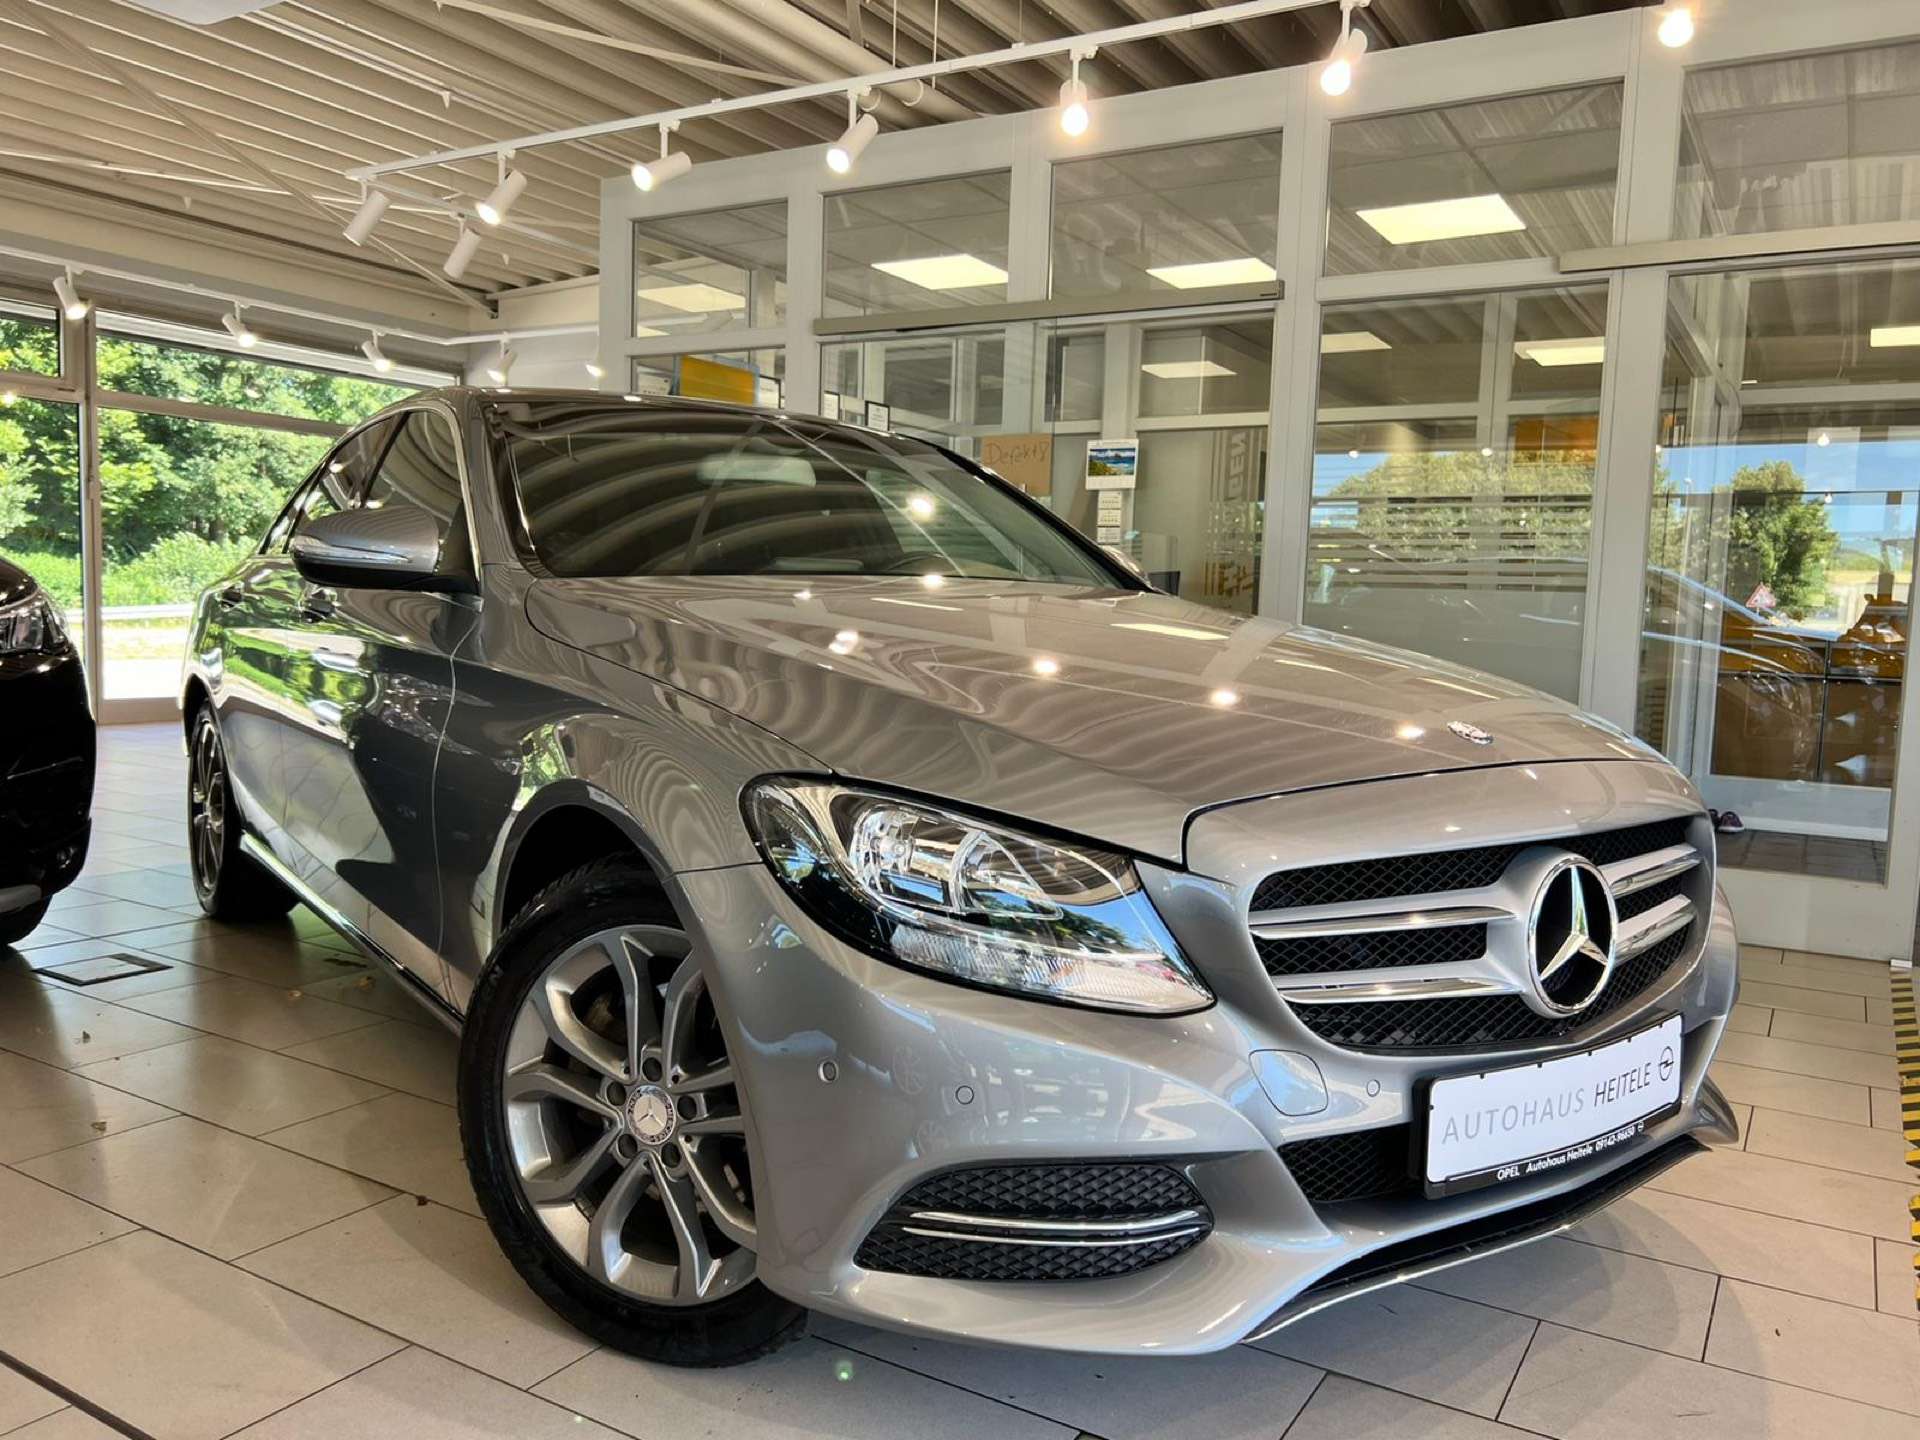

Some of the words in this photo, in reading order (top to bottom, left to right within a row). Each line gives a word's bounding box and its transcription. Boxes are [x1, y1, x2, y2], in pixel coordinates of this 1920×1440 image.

[1441, 1088, 1585, 1145] AUTOHAUS
[1593, 1062, 1652, 1107] HEITELE
[1496, 1165, 1520, 1181] OPEL
[1525, 1154, 1567, 1173] Autohaus
[1567, 1144, 1593, 1163] Heitele
